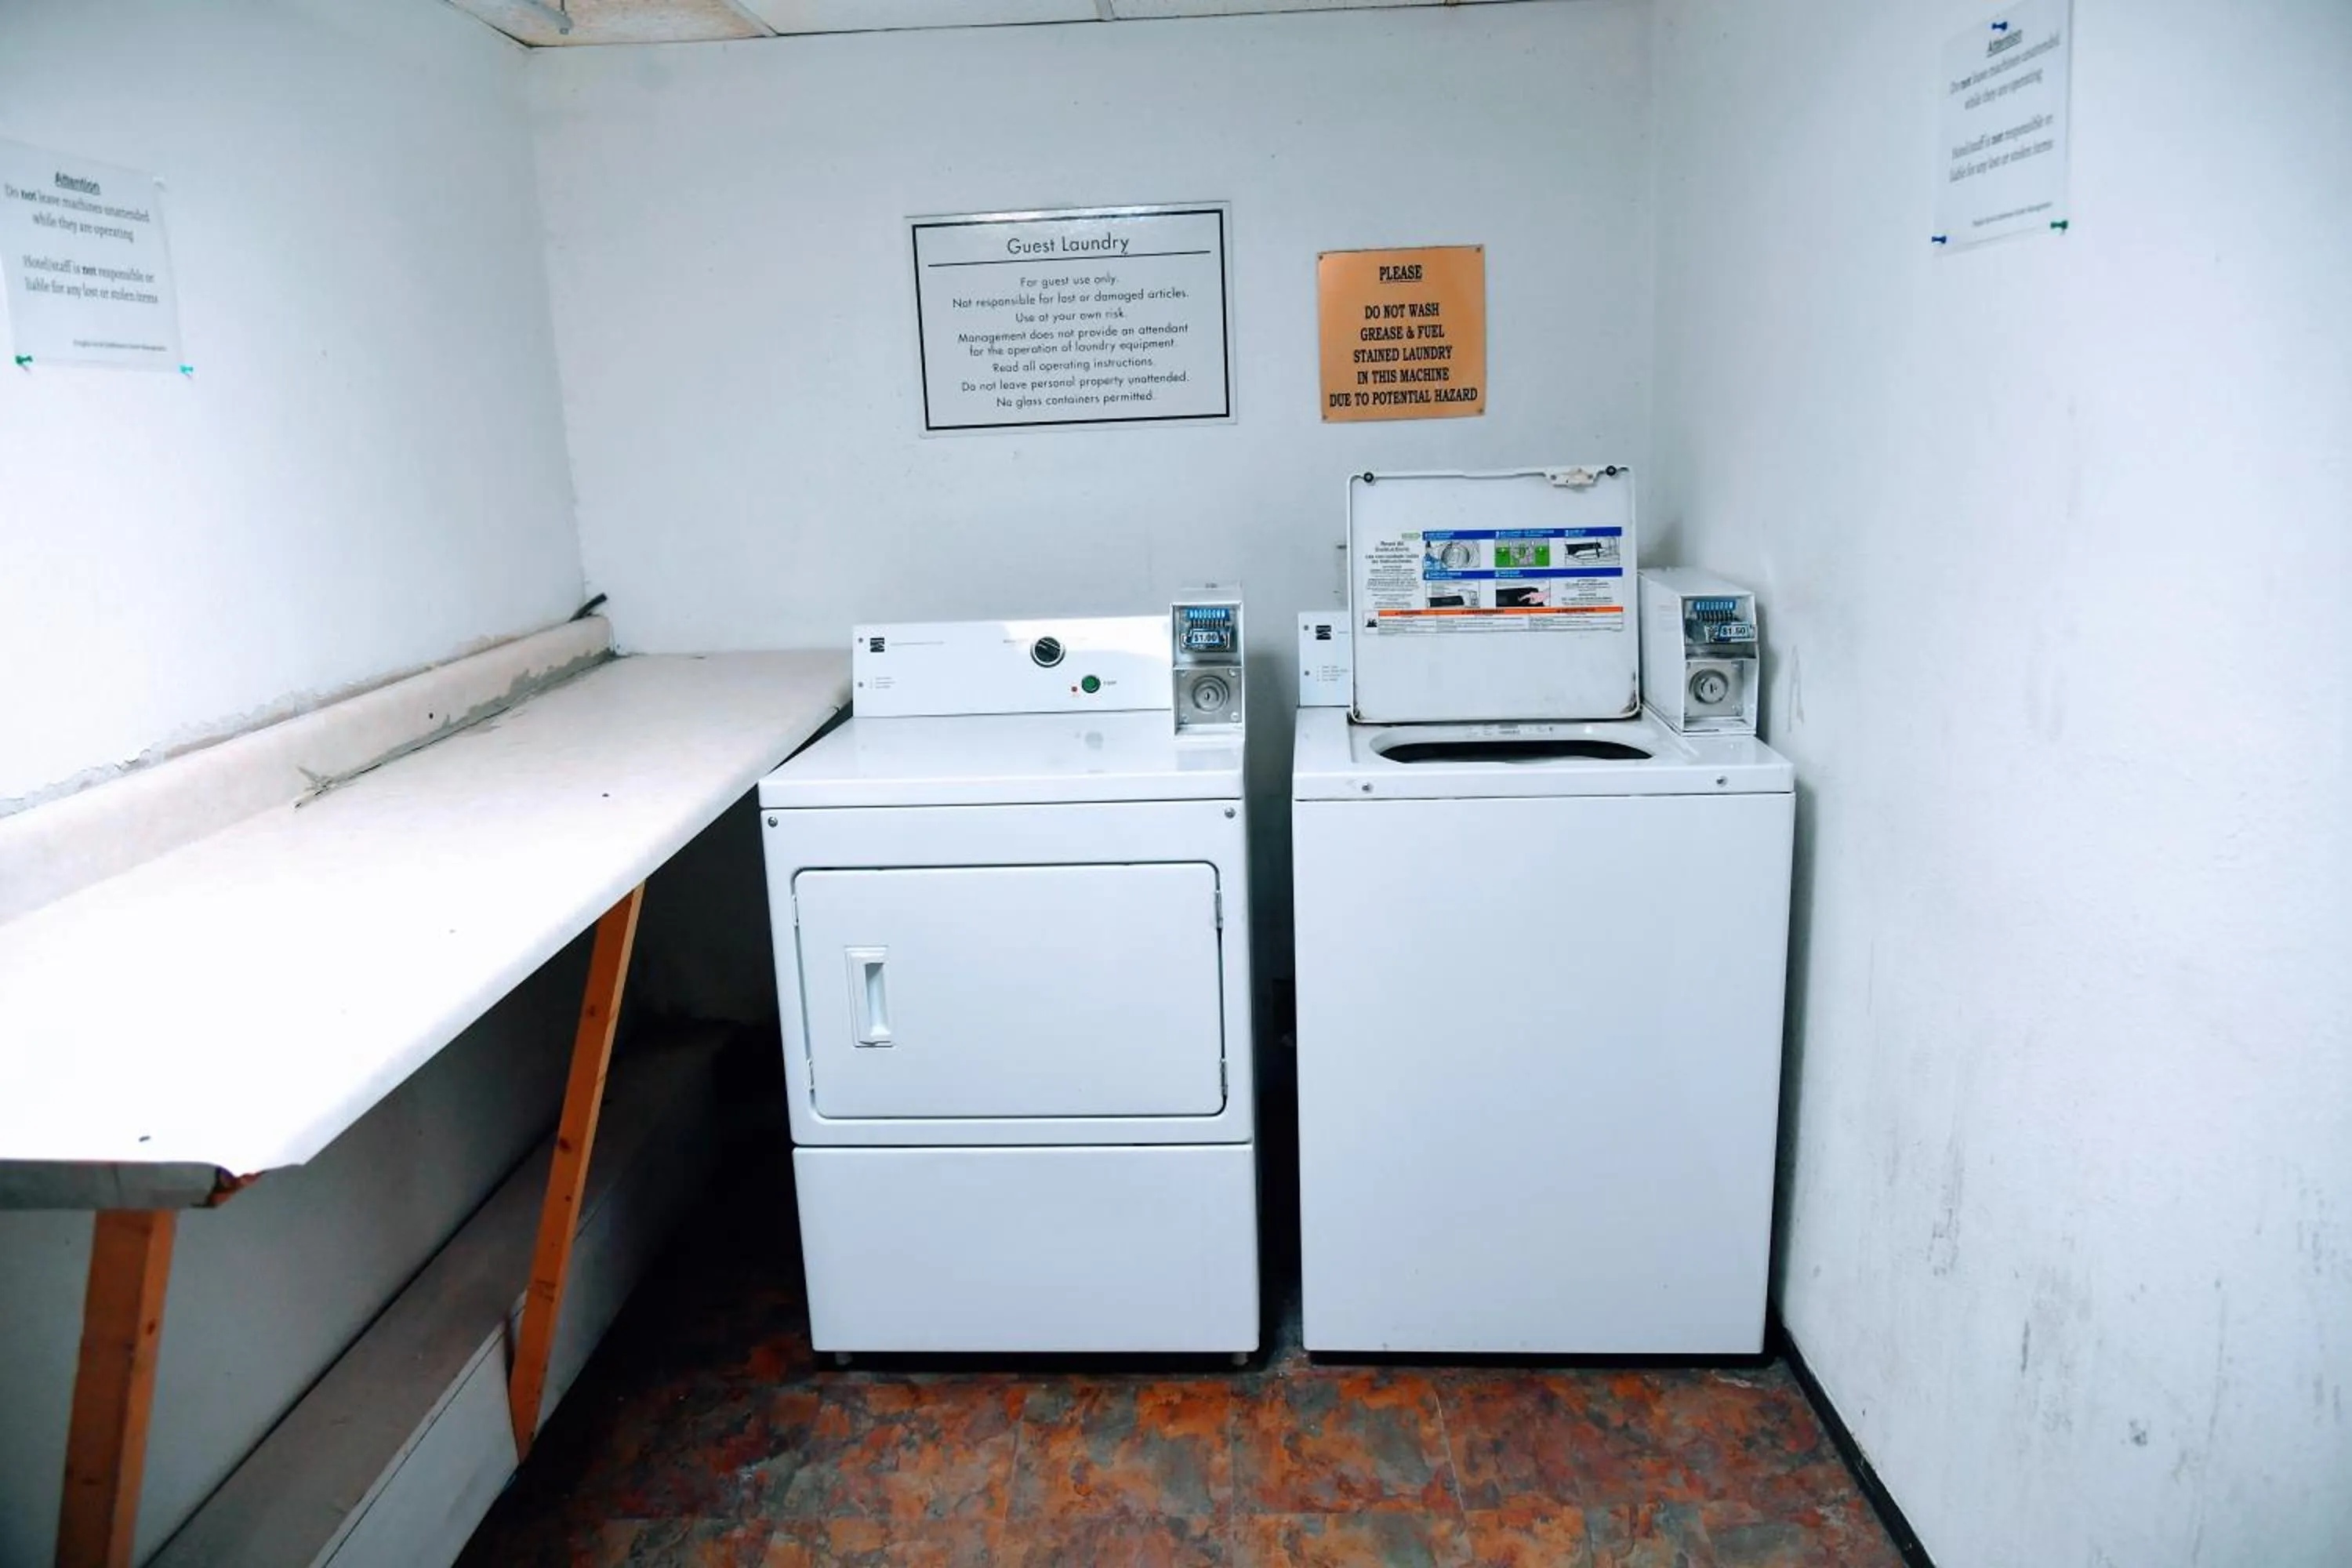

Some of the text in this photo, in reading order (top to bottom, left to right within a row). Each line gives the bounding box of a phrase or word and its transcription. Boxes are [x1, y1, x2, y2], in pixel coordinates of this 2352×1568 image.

[1007, 232, 1129, 255] Guest Laundry
[1379, 264, 1423, 281] PLEASE
[1020, 277, 1037, 288] For
[1041, 277, 1069, 289] guest
[1073, 276, 1091, 285] use
[953, 286, 1189, 309] Not responsible for lost or damaged articles.
[1015, 313, 1035, 323] Use
[1039, 313, 1049, 322] at
[1053, 312, 1076, 324] your
[1080, 311, 1102, 320] own
[1365, 303, 1440, 319] DO NOT WASH
[958, 332, 1026, 343] Management
[1029, 329, 1054, 340] does
[1058, 329, 1074, 338] not
[1078, 325, 1118, 339] provide
[1138, 322, 1189, 335] attendant
[1360, 325, 1445, 341] GREASE & FUEL
[970, 345, 984, 357] for
[988, 345, 1004, 355] the
[1007, 344, 1058, 357] operation
[1061, 341, 1073, 352] of
[1075, 339, 1115, 352] laundry
[1353, 346, 1453, 363] STAINED LAUNDRY
[993, 361, 1019, 372] Read
[1022, 361, 1036, 372] all
[1039, 360, 1091, 372] operating
[962, 370, 1190, 391] Do not leave personal property unattended.
[1357, 367, 1450, 385] IN THIS MACHINE
[996, 397, 1012, 407] No
[1015, 397, 1042, 408] glass
[1046, 394, 1100, 405] containers
[1330, 388, 1478, 407] DUE TO POTENTIAL HAZARD
